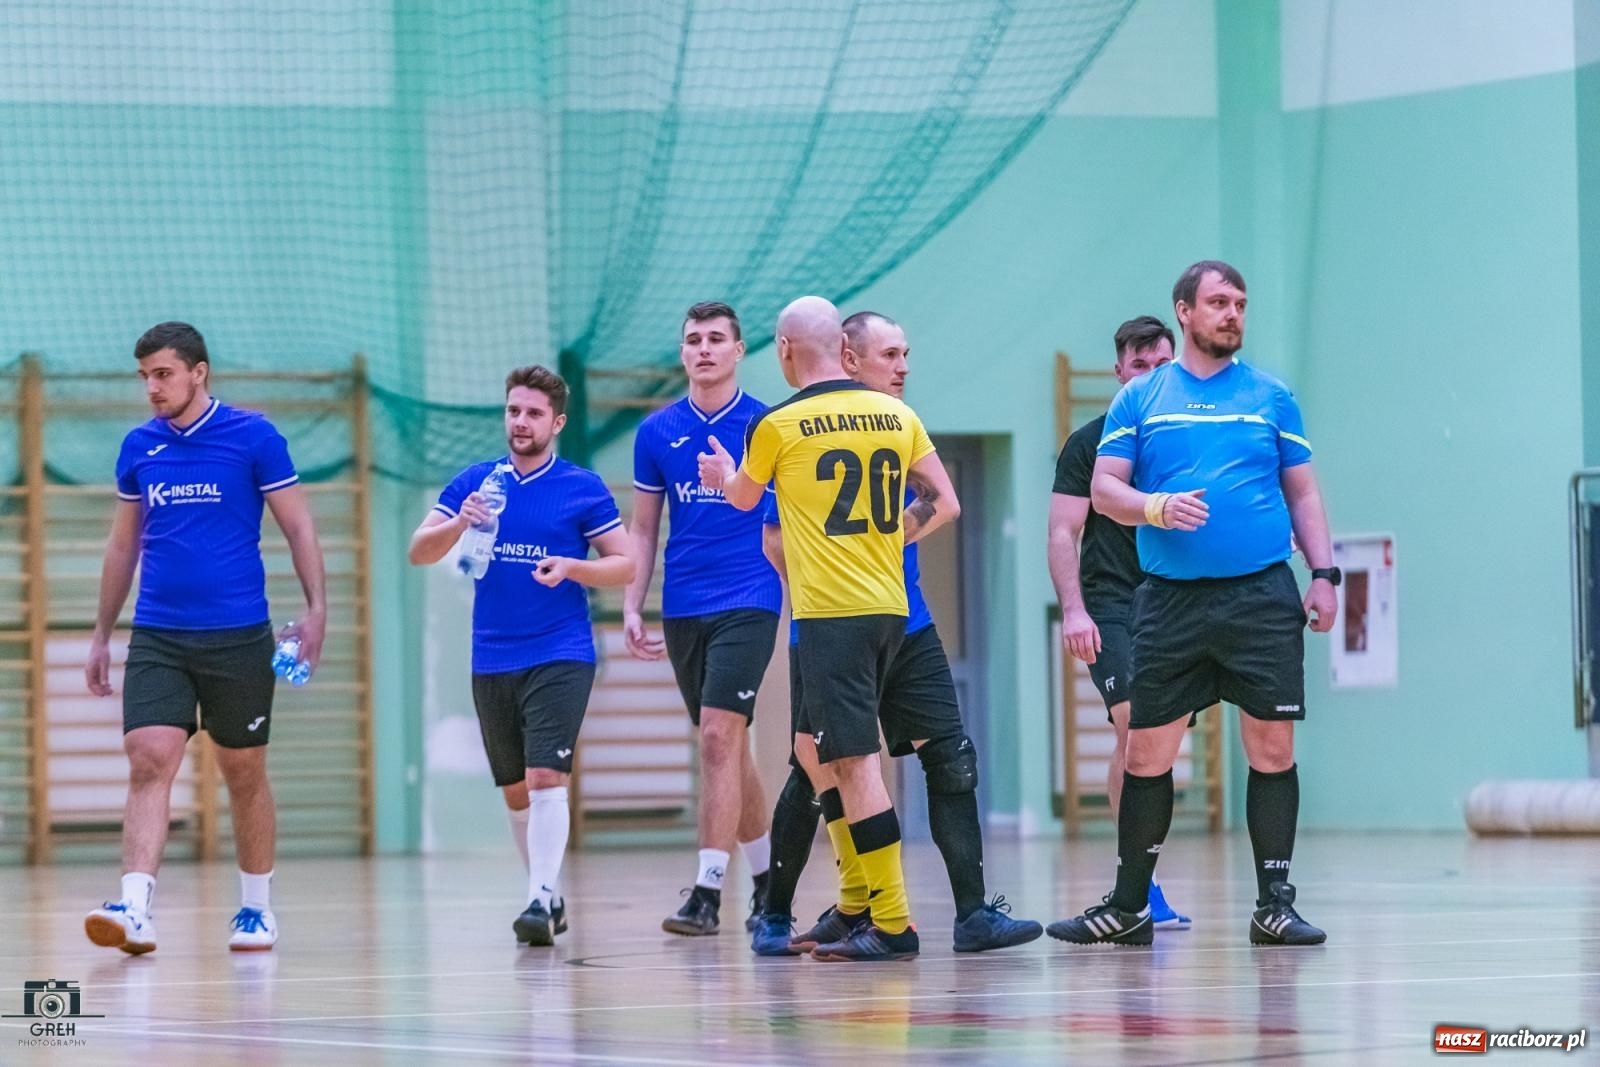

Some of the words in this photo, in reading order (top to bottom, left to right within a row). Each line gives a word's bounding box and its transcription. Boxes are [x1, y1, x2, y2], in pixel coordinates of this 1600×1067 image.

[799, 413, 903, 437] GALAKTIKOS
[147, 482, 222, 507] K-INSTAL
[815, 447, 902, 536] 20
